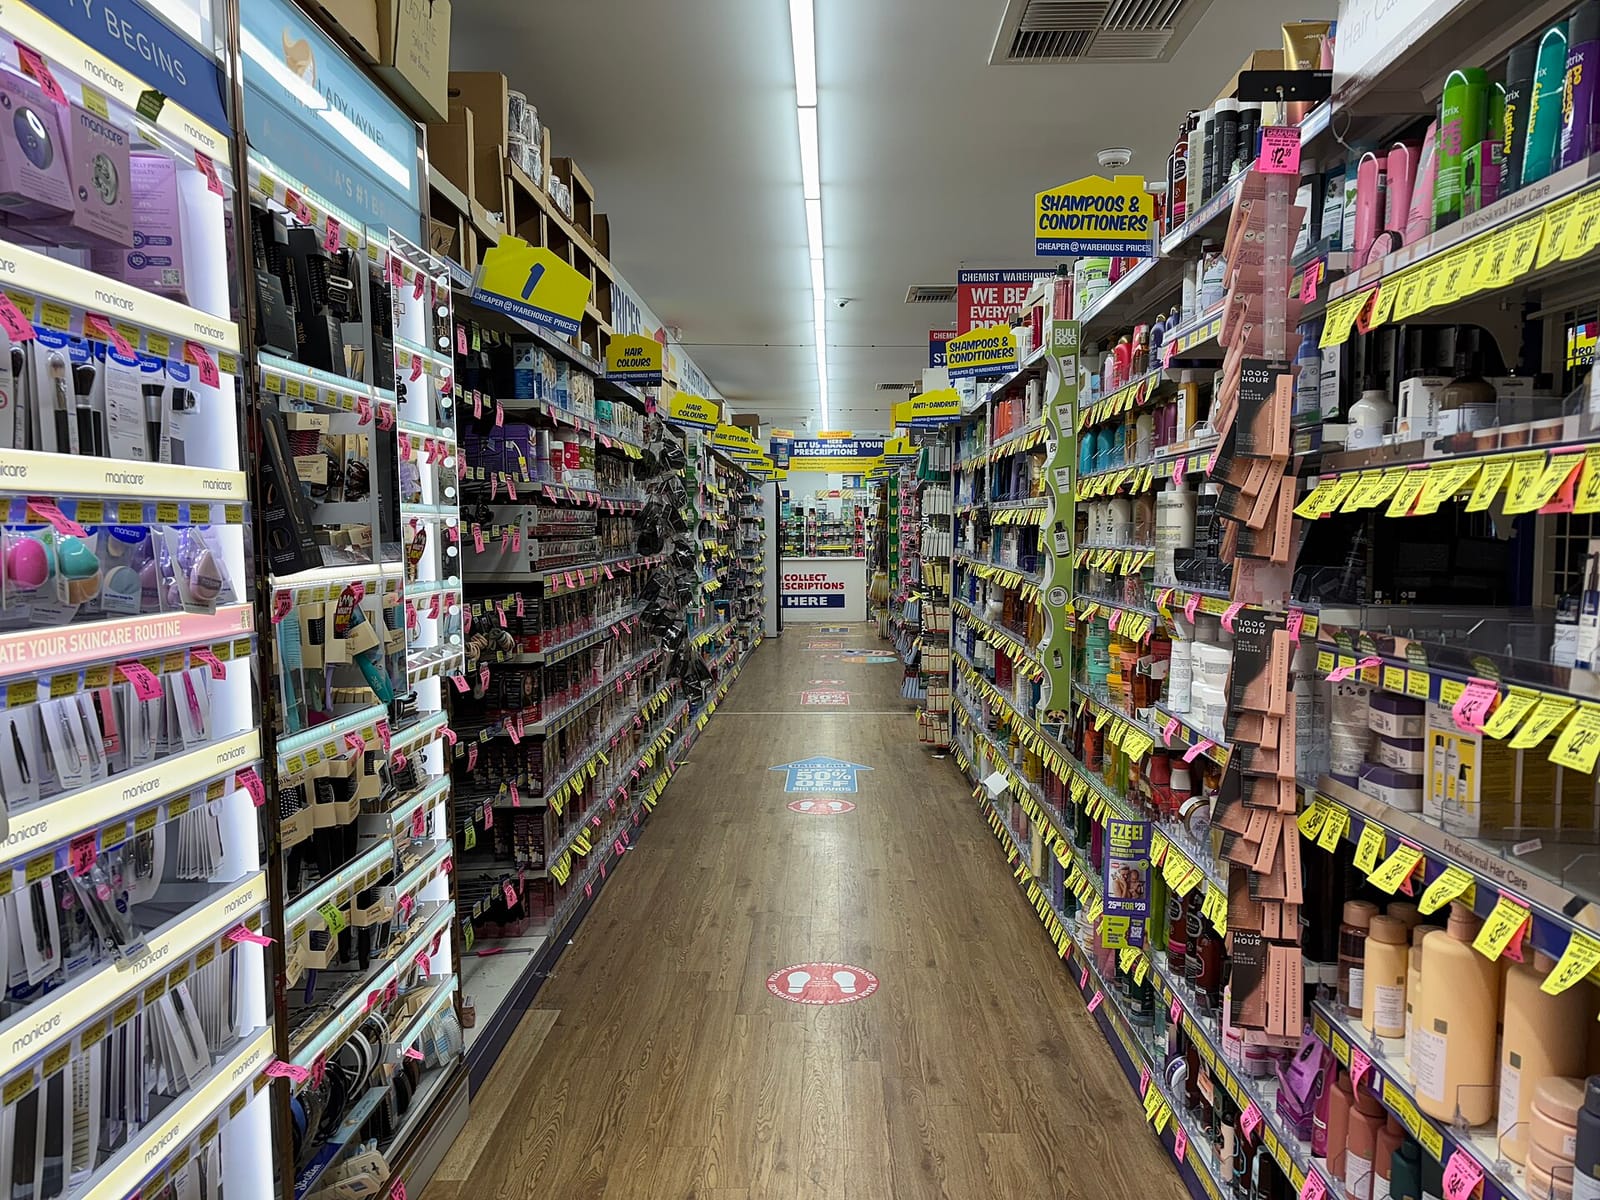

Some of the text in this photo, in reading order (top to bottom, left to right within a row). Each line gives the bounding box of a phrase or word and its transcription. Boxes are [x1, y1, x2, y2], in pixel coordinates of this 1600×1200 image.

[103, 8, 188, 86] BEGINS
[84, 59, 125, 92] manicare
[318, 79, 350, 117] LADY
[80, 114, 124, 146] manicare
[184, 122, 215, 149] manicare
[1040, 195, 1140, 212] SHAMPOOS &
[1510, 193, 1527, 211] Hair
[1529, 184, 1551, 203] Care
[1039, 213, 1148, 231] CONDITIONERS
[1037, 243, 1070, 251] CHEAPER
[1080, 243, 1124, 252] WAREHOUSE
[1126, 243, 1151, 252] PRICES
[521, 262, 546, 300] 1
[961, 272, 999, 282] CHEMIST
[95, 287, 134, 312] manicare
[970, 288, 999, 304] WE
[474, 292, 504, 308] CHEAPER
[512, 304, 553, 325] WAREHOUSE
[553, 318, 578, 332] PRICES
[194, 321, 225, 341] manicare
[1054, 328, 1077, 337] BULL
[949, 336, 1008, 353] SHAMPOOS &
[1054, 336, 1077, 345] DOG
[624, 347, 643, 356] HAIR
[949, 347, 1014, 364] CONDITIONERS
[616, 358, 651, 367] COLOURS
[1241, 369, 1269, 377] 1000
[1241, 376, 1269, 384] HOUR
[678, 410, 708, 420] COLOURS
[686, 403, 703, 411] HAIR
[728, 434, 749, 443] STYLING
[105, 470, 145, 486] manicare
[202, 478, 233, 492] manicare
[113, 525, 141, 539] manicare
[783, 573, 827, 582] COLLECT
[787, 596, 828, 606] HERE
[1238, 626, 1267, 635] HOUR
[1239, 619, 1266, 627] 1000
[28, 636, 67, 659] YOUR
[70, 628, 131, 652] SKINCARE
[135, 620, 181, 641] ROUTINE
[216, 745, 247, 765] manicare
[796, 771, 852, 780] 50%
[122, 777, 160, 801] manicare
[1110, 822, 1144, 840] EZEE!
[1443, 838, 1528, 891] Professional Hair Care
[224, 890, 254, 915] manicare
[1233, 937, 1261, 946] HOUR
[132, 943, 170, 975] manicare
[12, 1013, 61, 1054] manicare
[231, 1048, 260, 1081] manicare
[144, 1124, 181, 1164] manicare
